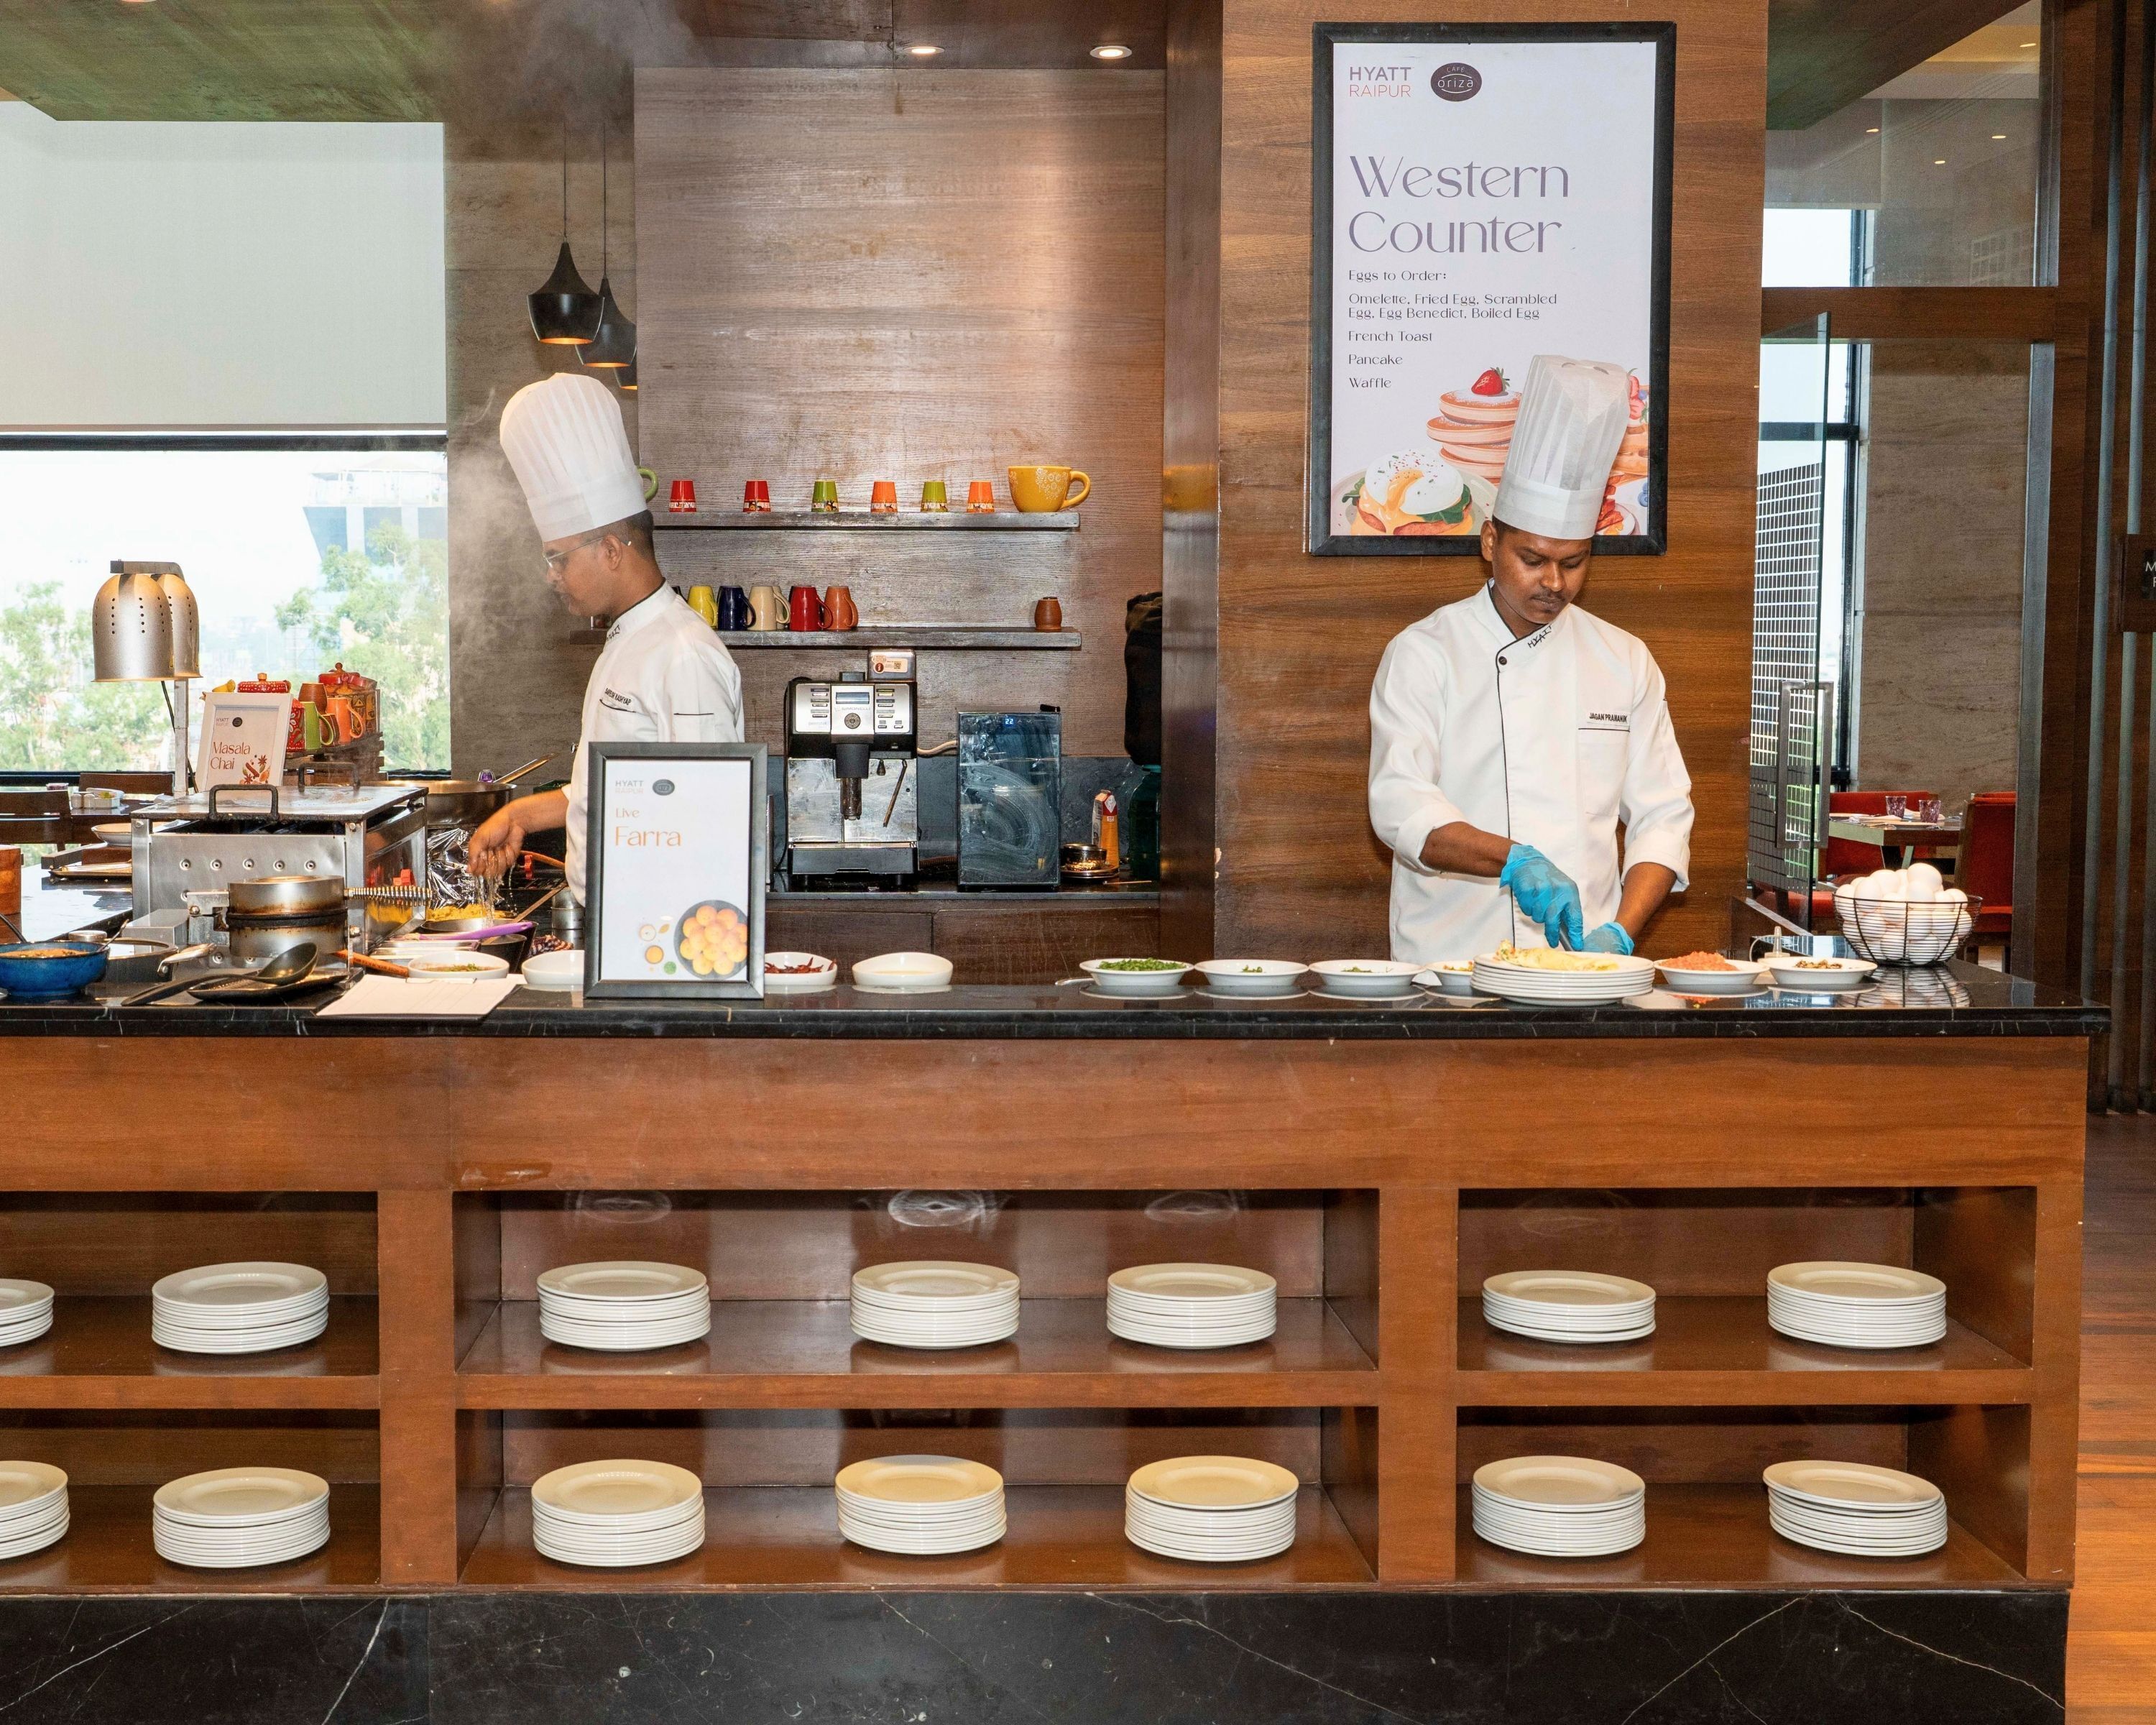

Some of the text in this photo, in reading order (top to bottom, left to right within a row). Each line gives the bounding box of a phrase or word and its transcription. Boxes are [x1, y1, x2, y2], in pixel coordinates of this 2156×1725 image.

[1350, 67, 1411, 81] HYATT
[1437, 78, 1473, 88] oriza
[1350, 85, 1411, 98] RAIPUR
[1350, 156, 1569, 198] Western
[1348, 211, 1562, 253] Counter
[1349, 270, 1447, 282] Eggs to Order:
[1349, 293, 1557, 306] Omelette, Fried Egg, Scrambled
[1349, 308, 1540, 321] Egg, Egg Benedict, Boiled Egg
[1349, 331, 1432, 341] French Toast
[1348, 354, 1403, 364] Pancake
[1349, 377, 1391, 388] Waffle
[1527, 625, 1552, 648] HYATT
[1589, 712, 1628, 723] JAGAN PRAMANIK
[213, 741, 251, 755] Masala
[210, 756, 235, 770] Chai
[615, 807, 640, 818] Live
[615, 826, 682, 847] Farra
